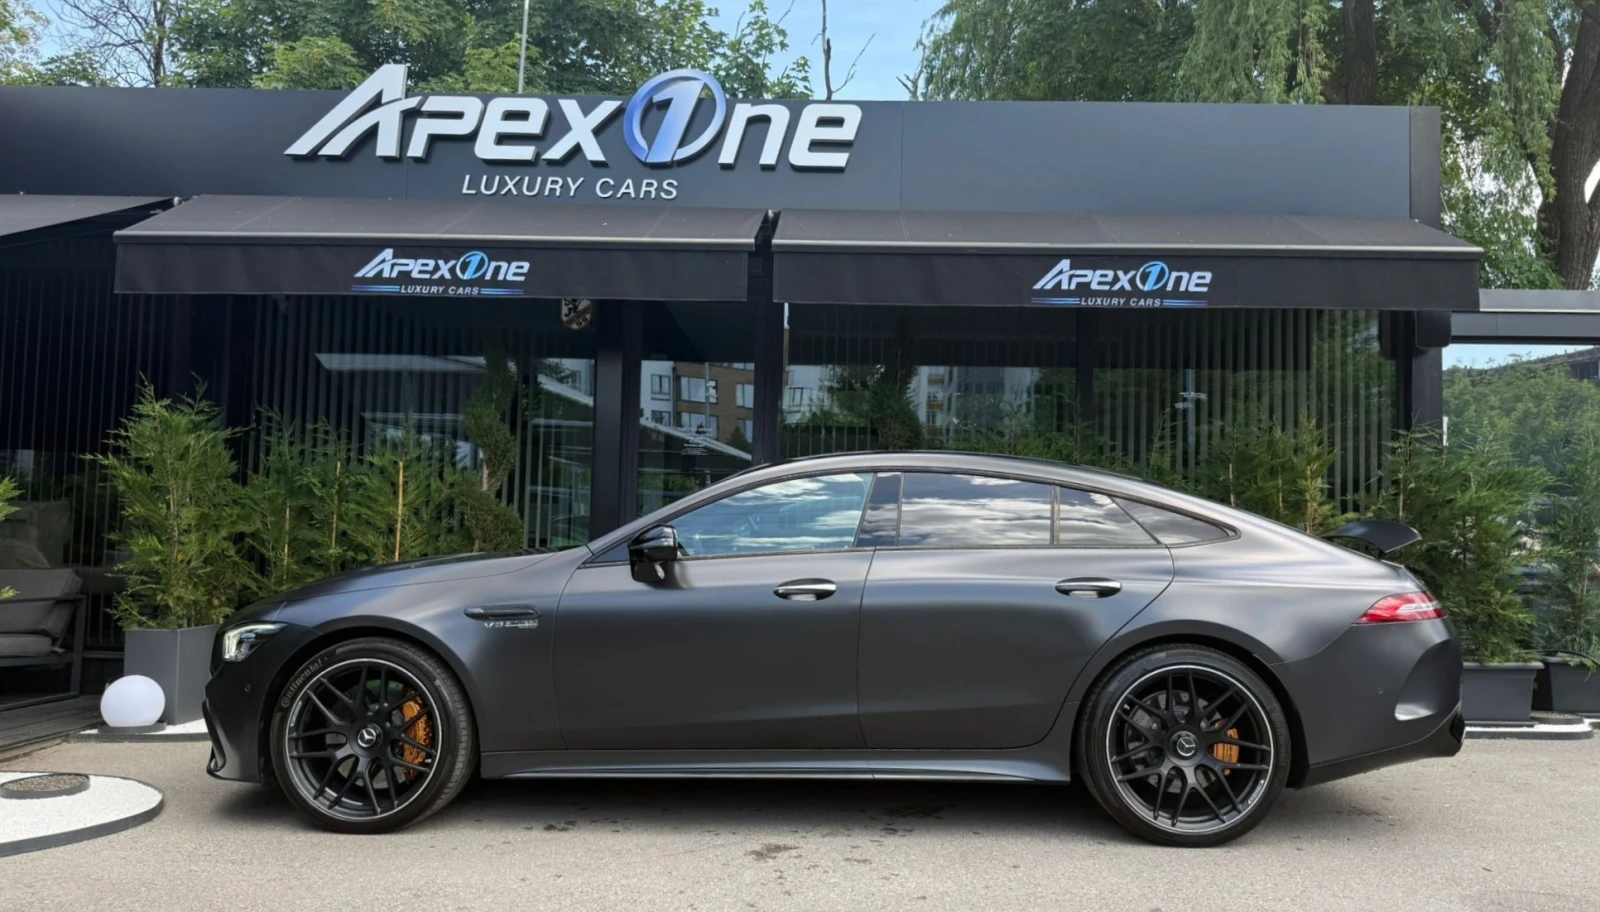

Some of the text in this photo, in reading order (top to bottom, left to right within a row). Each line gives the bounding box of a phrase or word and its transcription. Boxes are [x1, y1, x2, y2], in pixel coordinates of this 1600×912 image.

[462, 174, 679, 200] LUXURY CARS
[401, 285, 481, 295] LUXURY CARS
[1080, 297, 1161, 307] LUXURY CARS
[281, 658, 322, 708] Continental
